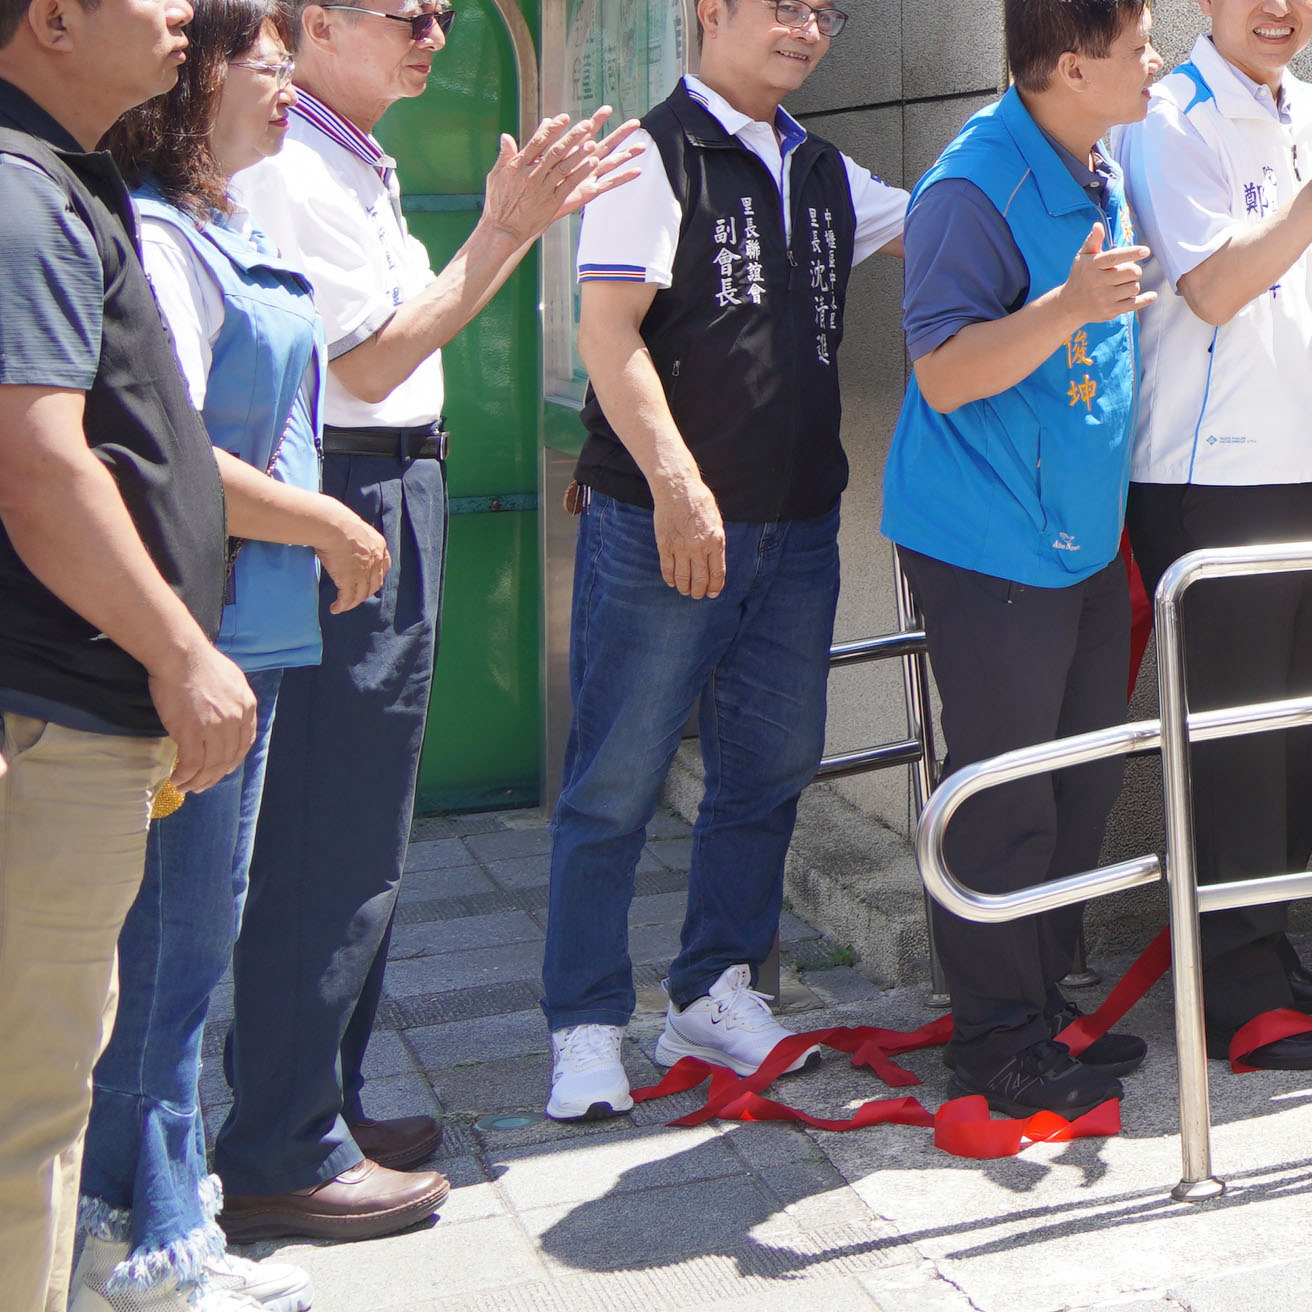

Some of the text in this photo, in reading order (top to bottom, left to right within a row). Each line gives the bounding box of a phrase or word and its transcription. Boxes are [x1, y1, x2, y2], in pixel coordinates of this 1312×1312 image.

[712, 216, 743, 308] 副會長
[740, 196, 767, 305] 里長聯誼會
